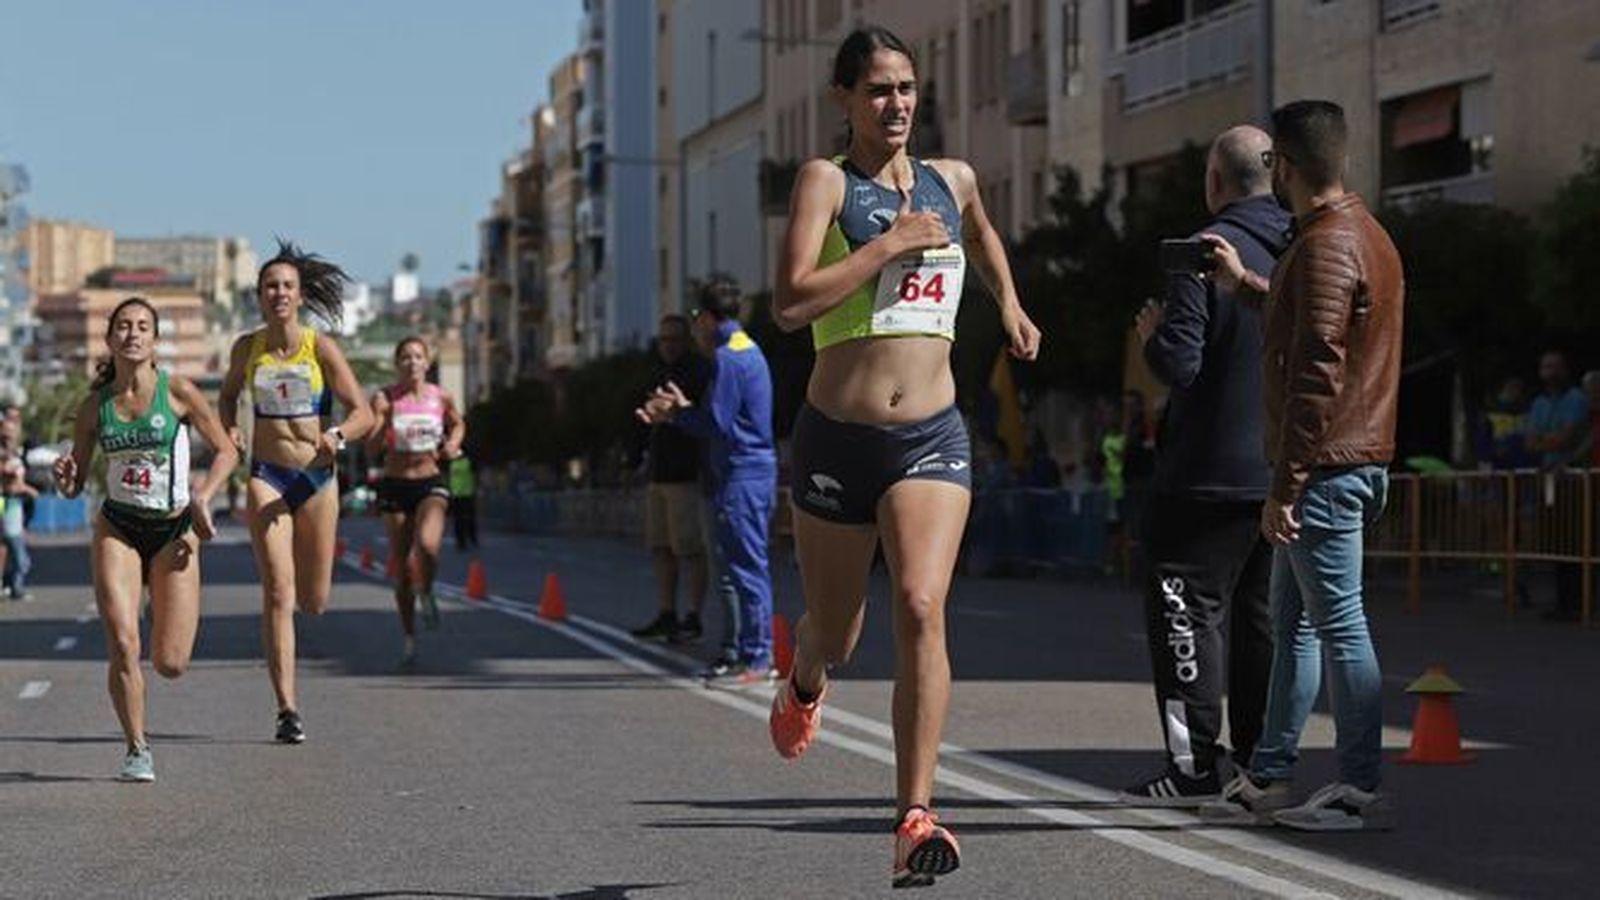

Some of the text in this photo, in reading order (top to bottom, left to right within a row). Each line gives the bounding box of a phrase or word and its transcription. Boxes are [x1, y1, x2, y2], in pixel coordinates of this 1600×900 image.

[900, 271, 945, 303] 64
[276, 382, 287, 399] 1
[121, 467, 150, 489] 44
[1162, 577, 1198, 682] adidas
